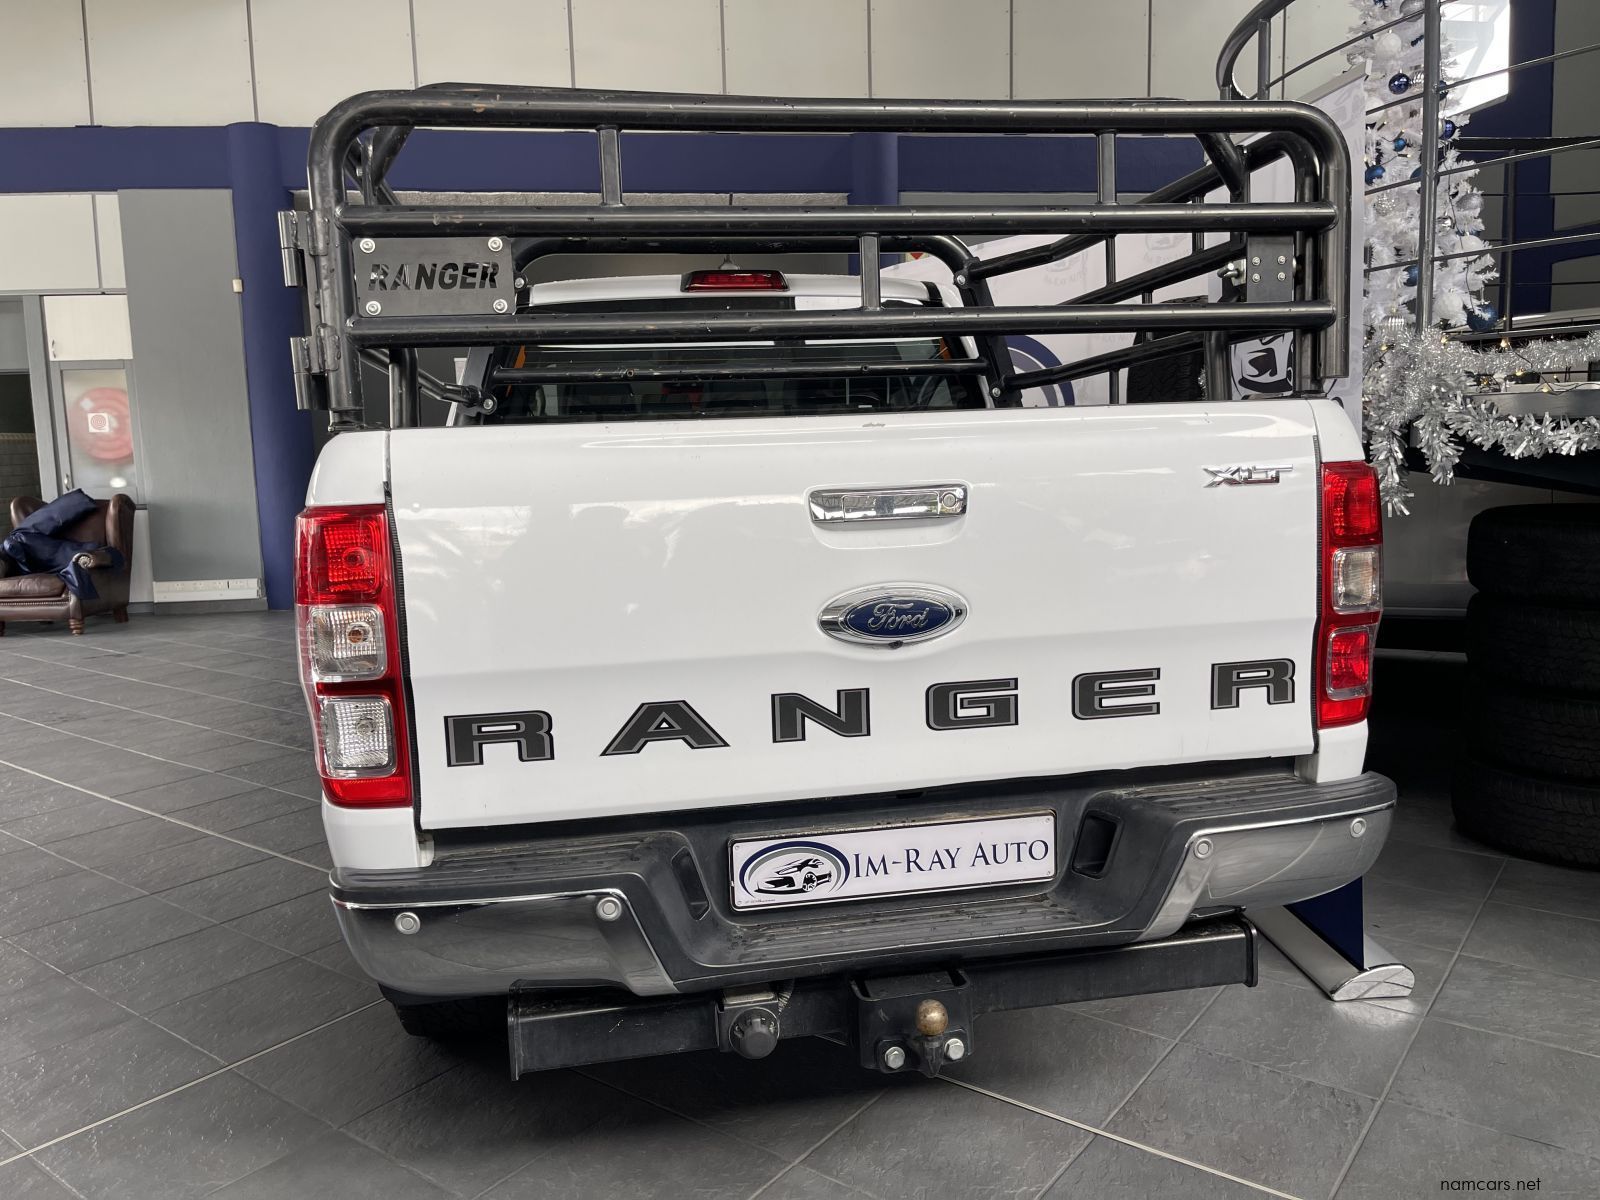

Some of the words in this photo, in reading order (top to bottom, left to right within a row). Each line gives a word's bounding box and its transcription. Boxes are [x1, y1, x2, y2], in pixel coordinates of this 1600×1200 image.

[368, 262, 500, 291] RANGER
[1203, 463, 1293, 488] XLT
[867, 602, 929, 631] Ford
[444, 658, 1295, 767] RANGER
[970, 839, 1049, 867] AUTO
